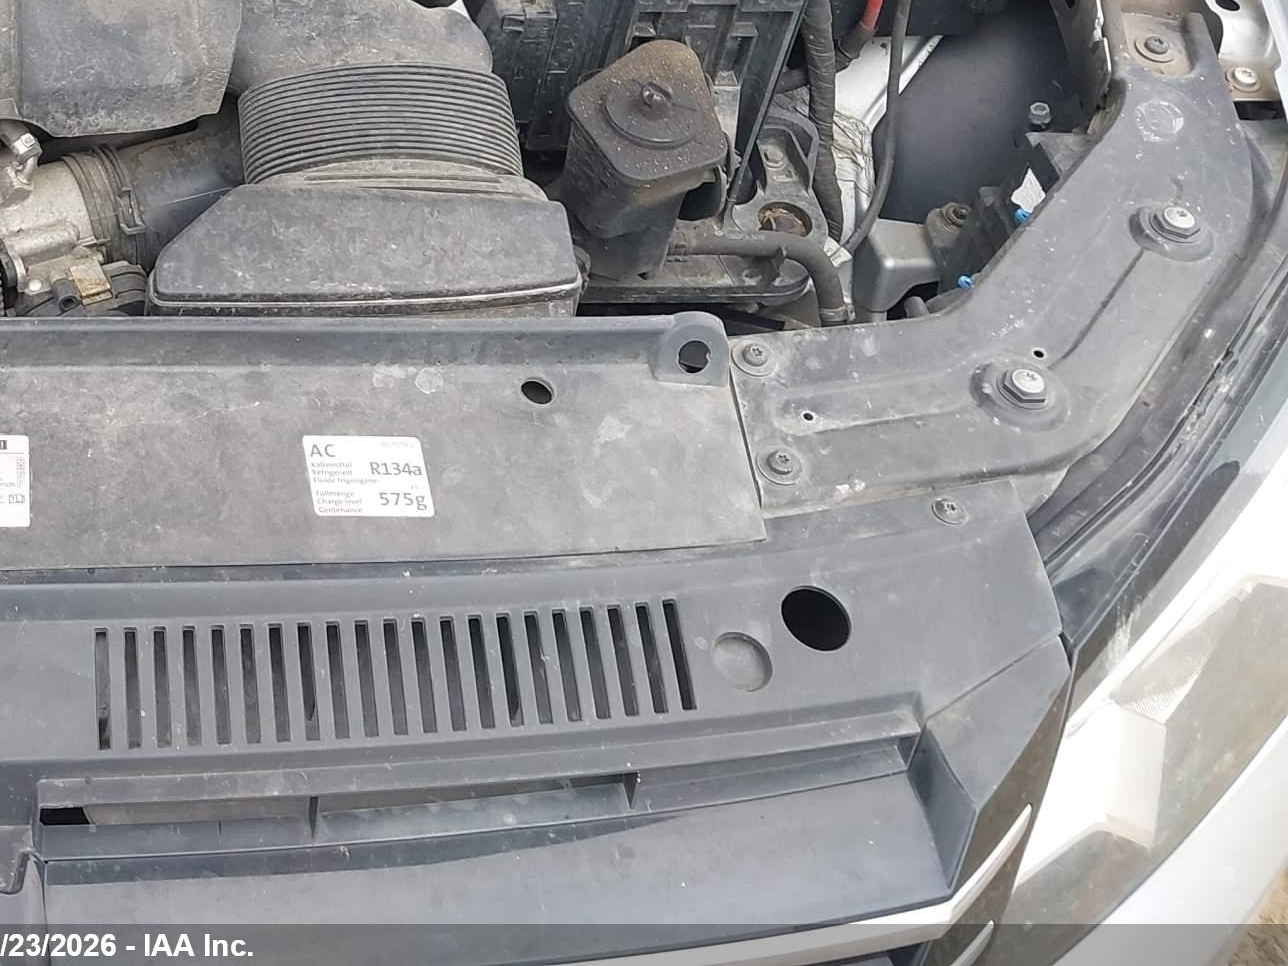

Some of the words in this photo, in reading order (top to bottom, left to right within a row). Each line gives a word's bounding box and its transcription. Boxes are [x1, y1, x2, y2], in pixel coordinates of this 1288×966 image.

[369, 461, 423, 476] R134a
[317, 498, 344, 506] Charge
[344, 498, 363, 506] level
[379, 492, 428, 511] 575g
